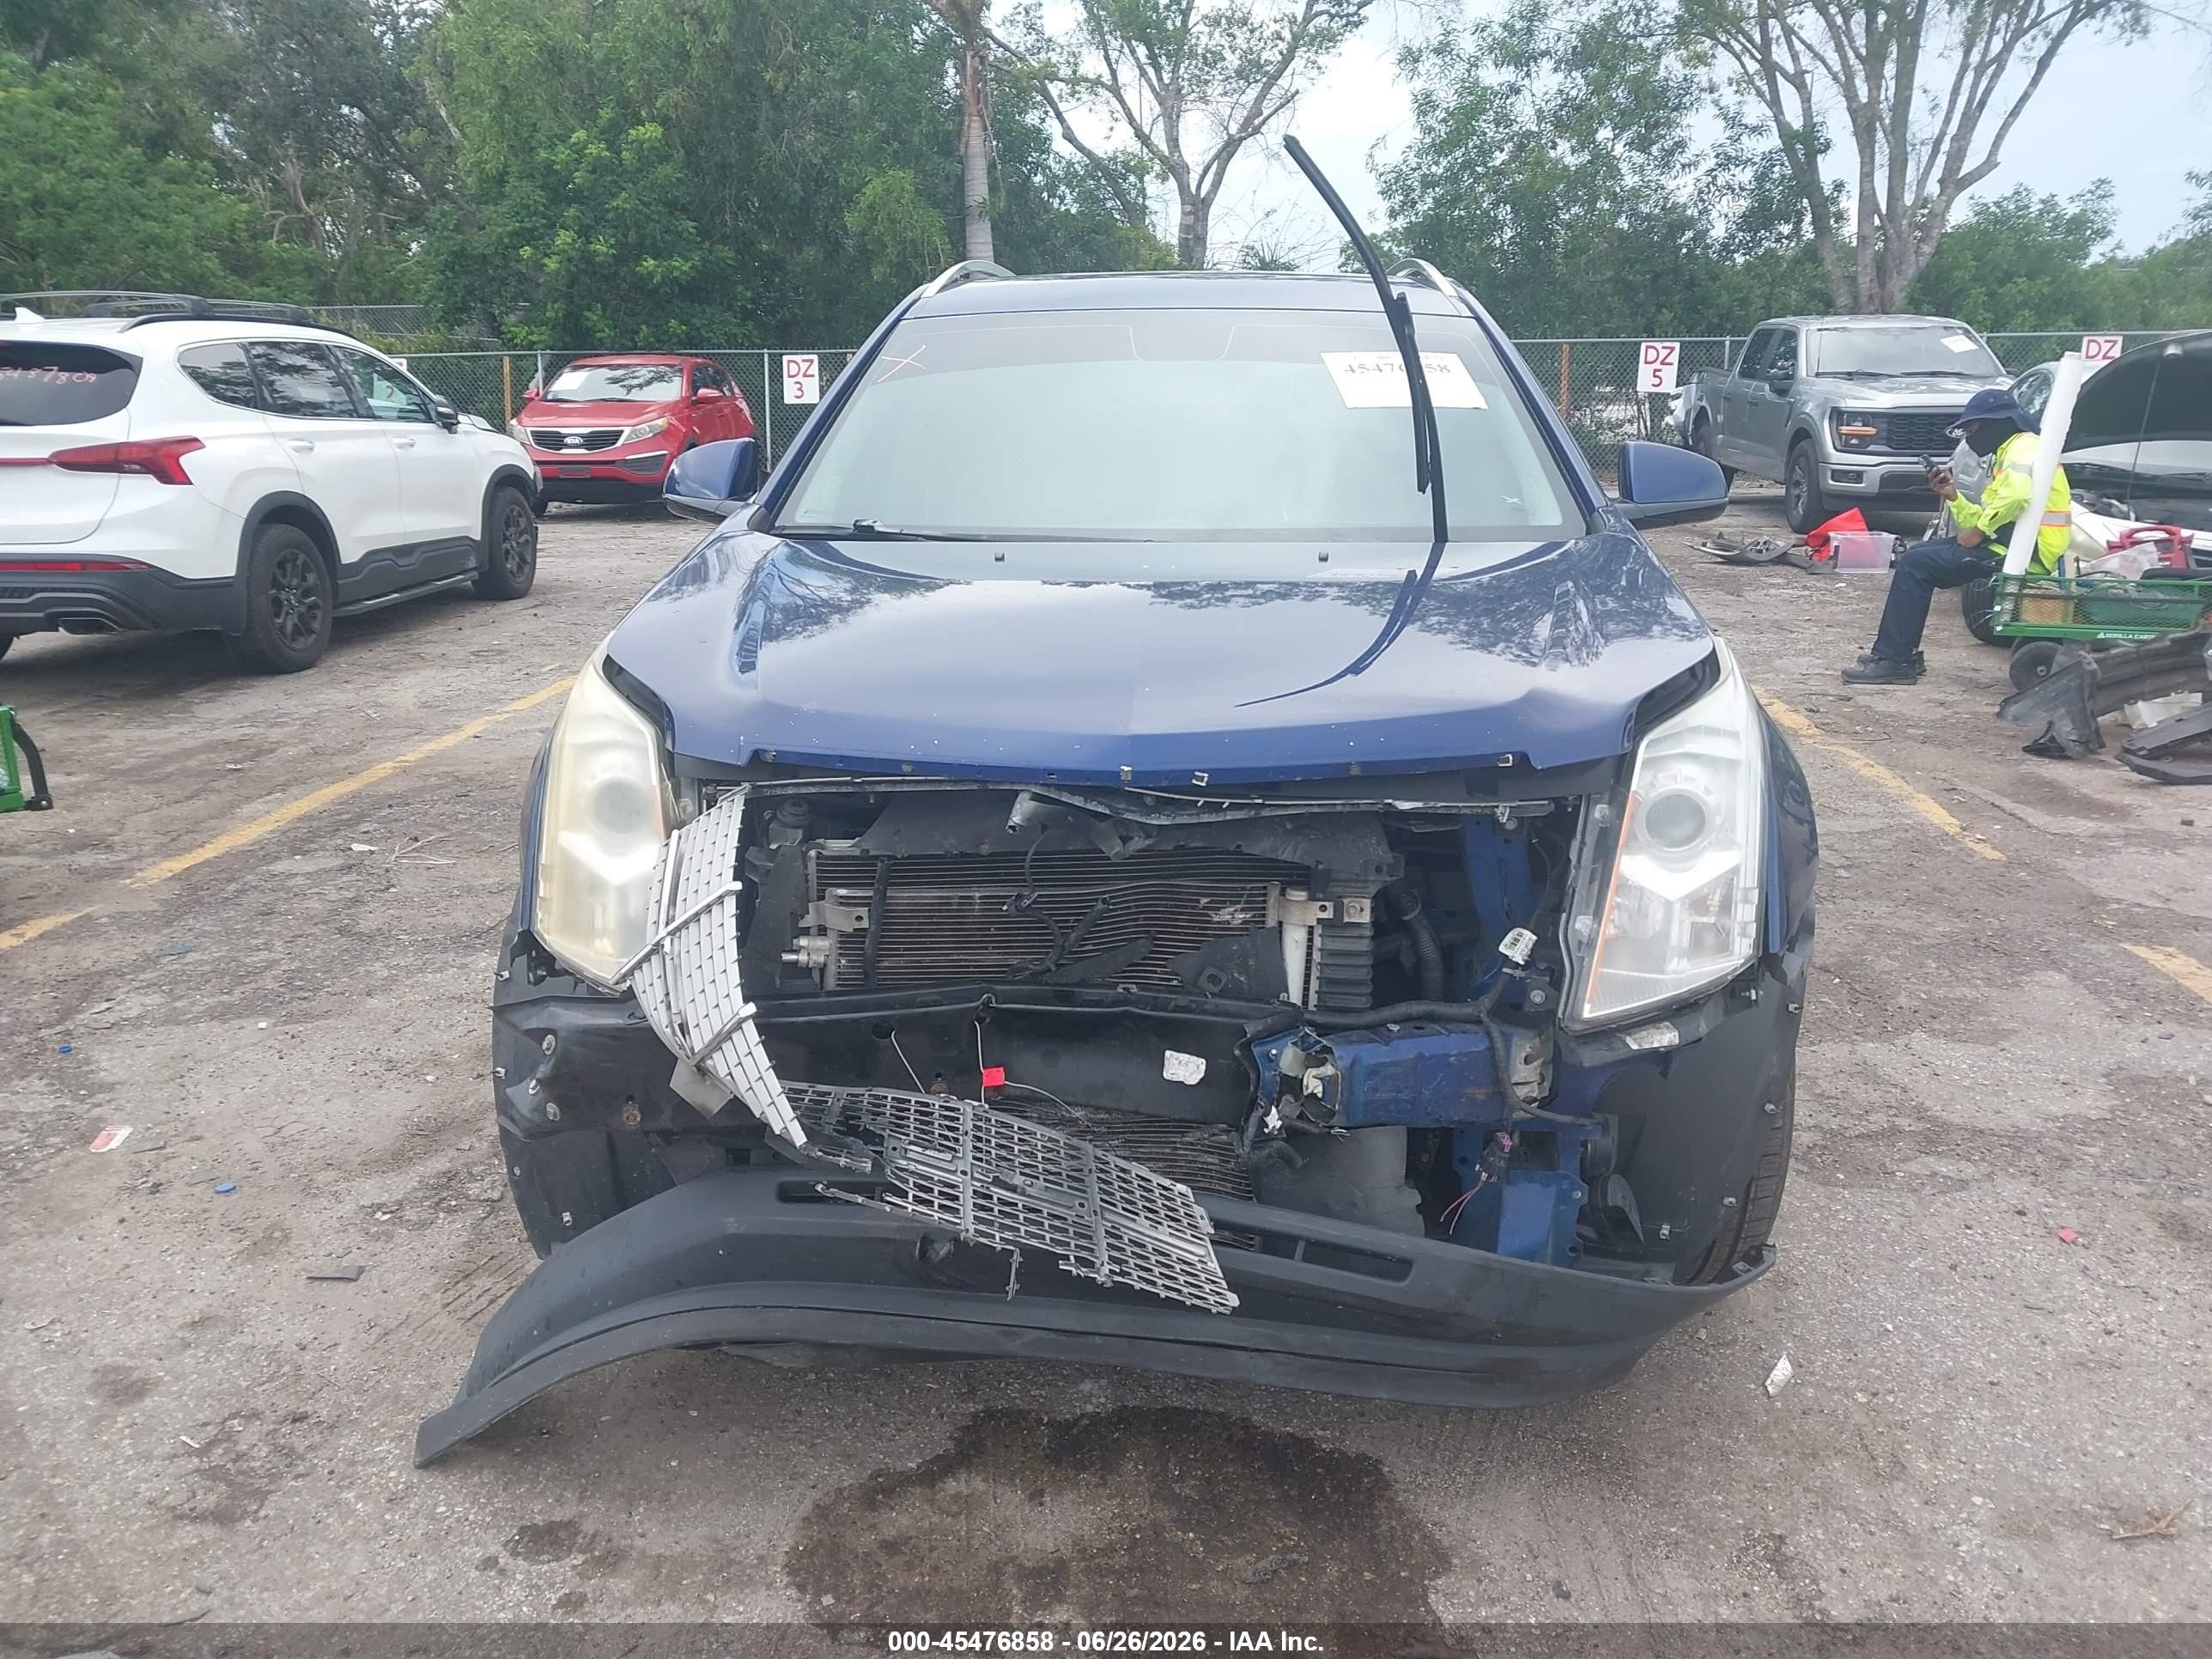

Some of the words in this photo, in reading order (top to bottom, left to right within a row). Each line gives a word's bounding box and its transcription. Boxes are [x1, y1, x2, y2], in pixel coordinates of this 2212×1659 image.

[1644, 345, 1675, 366] DZ
[2085, 338, 2118, 360] DZ
[787, 358, 815, 378] DZ
[1650, 368, 1663, 387] 5
[793, 380, 805, 399] 3
